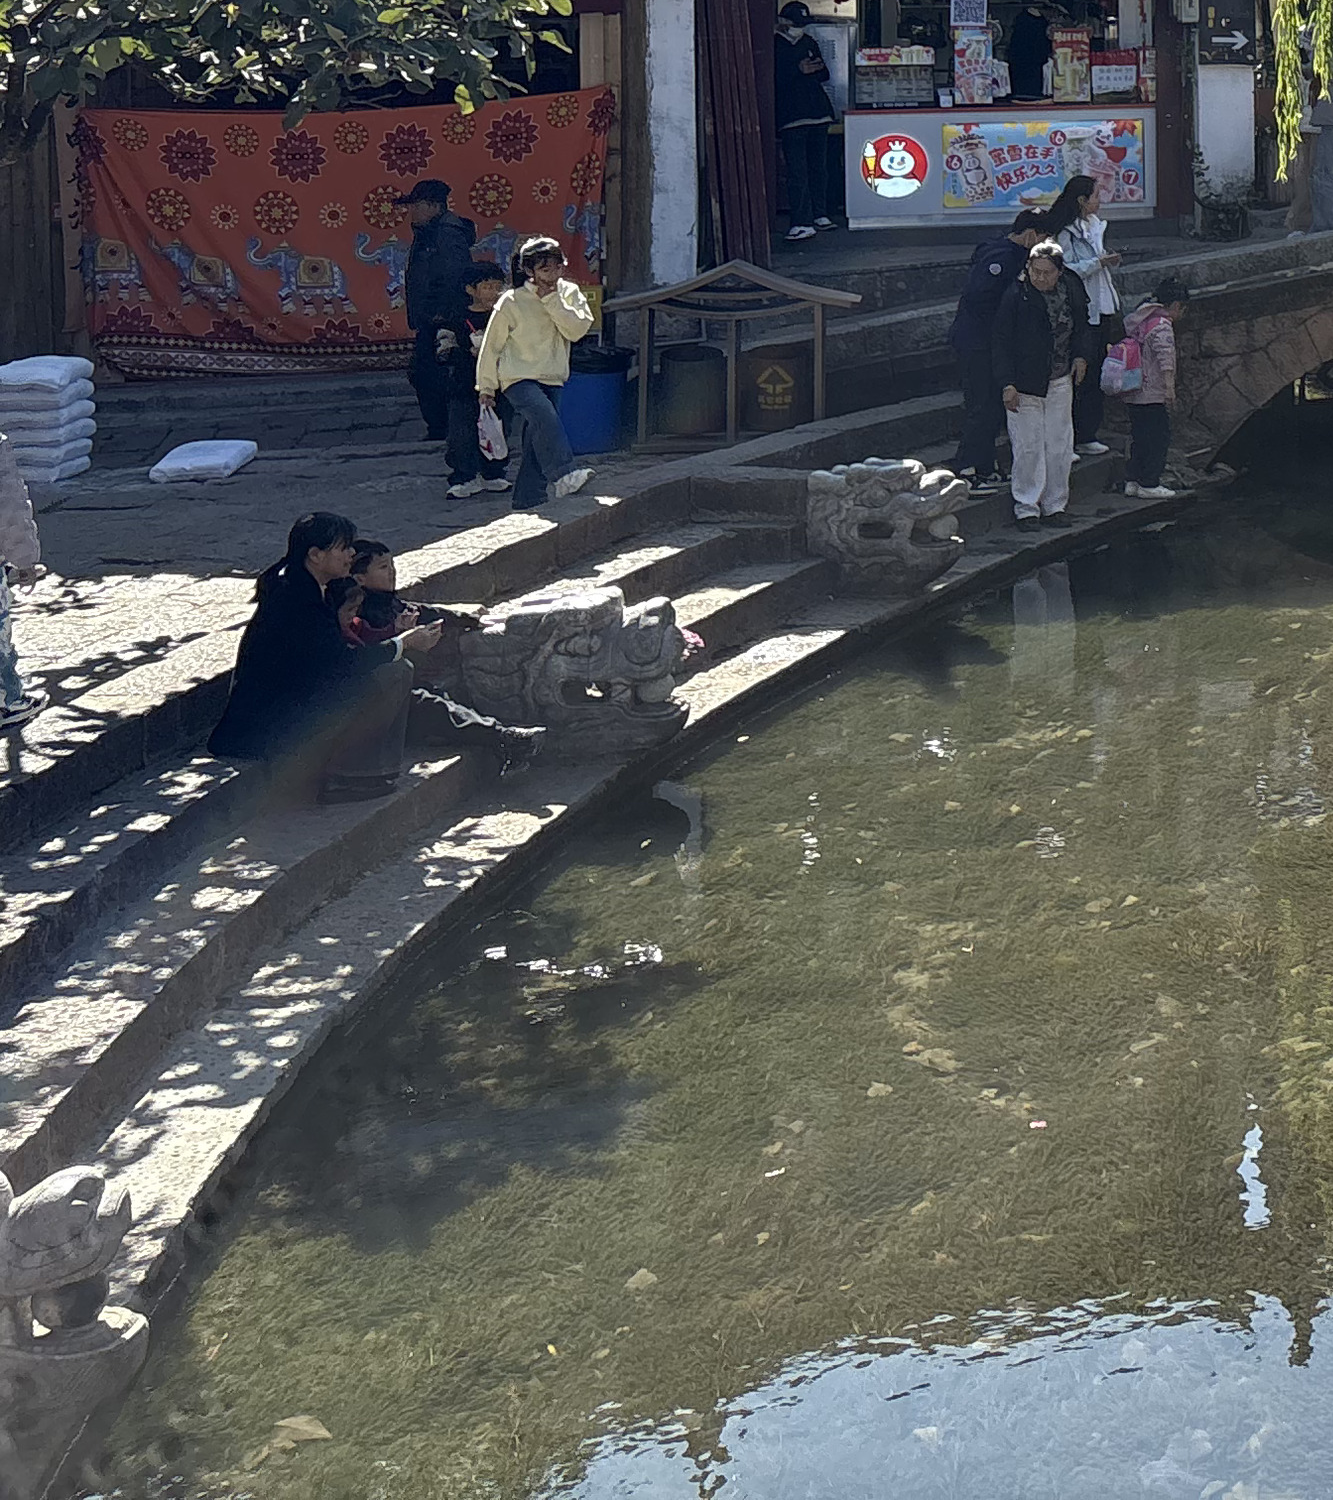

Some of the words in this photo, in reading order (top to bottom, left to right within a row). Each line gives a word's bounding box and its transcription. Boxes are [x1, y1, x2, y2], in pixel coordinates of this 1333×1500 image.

[988, 144, 1056, 168] 蜜雪在手
[994, 163, 1057, 192] 快乐久久
